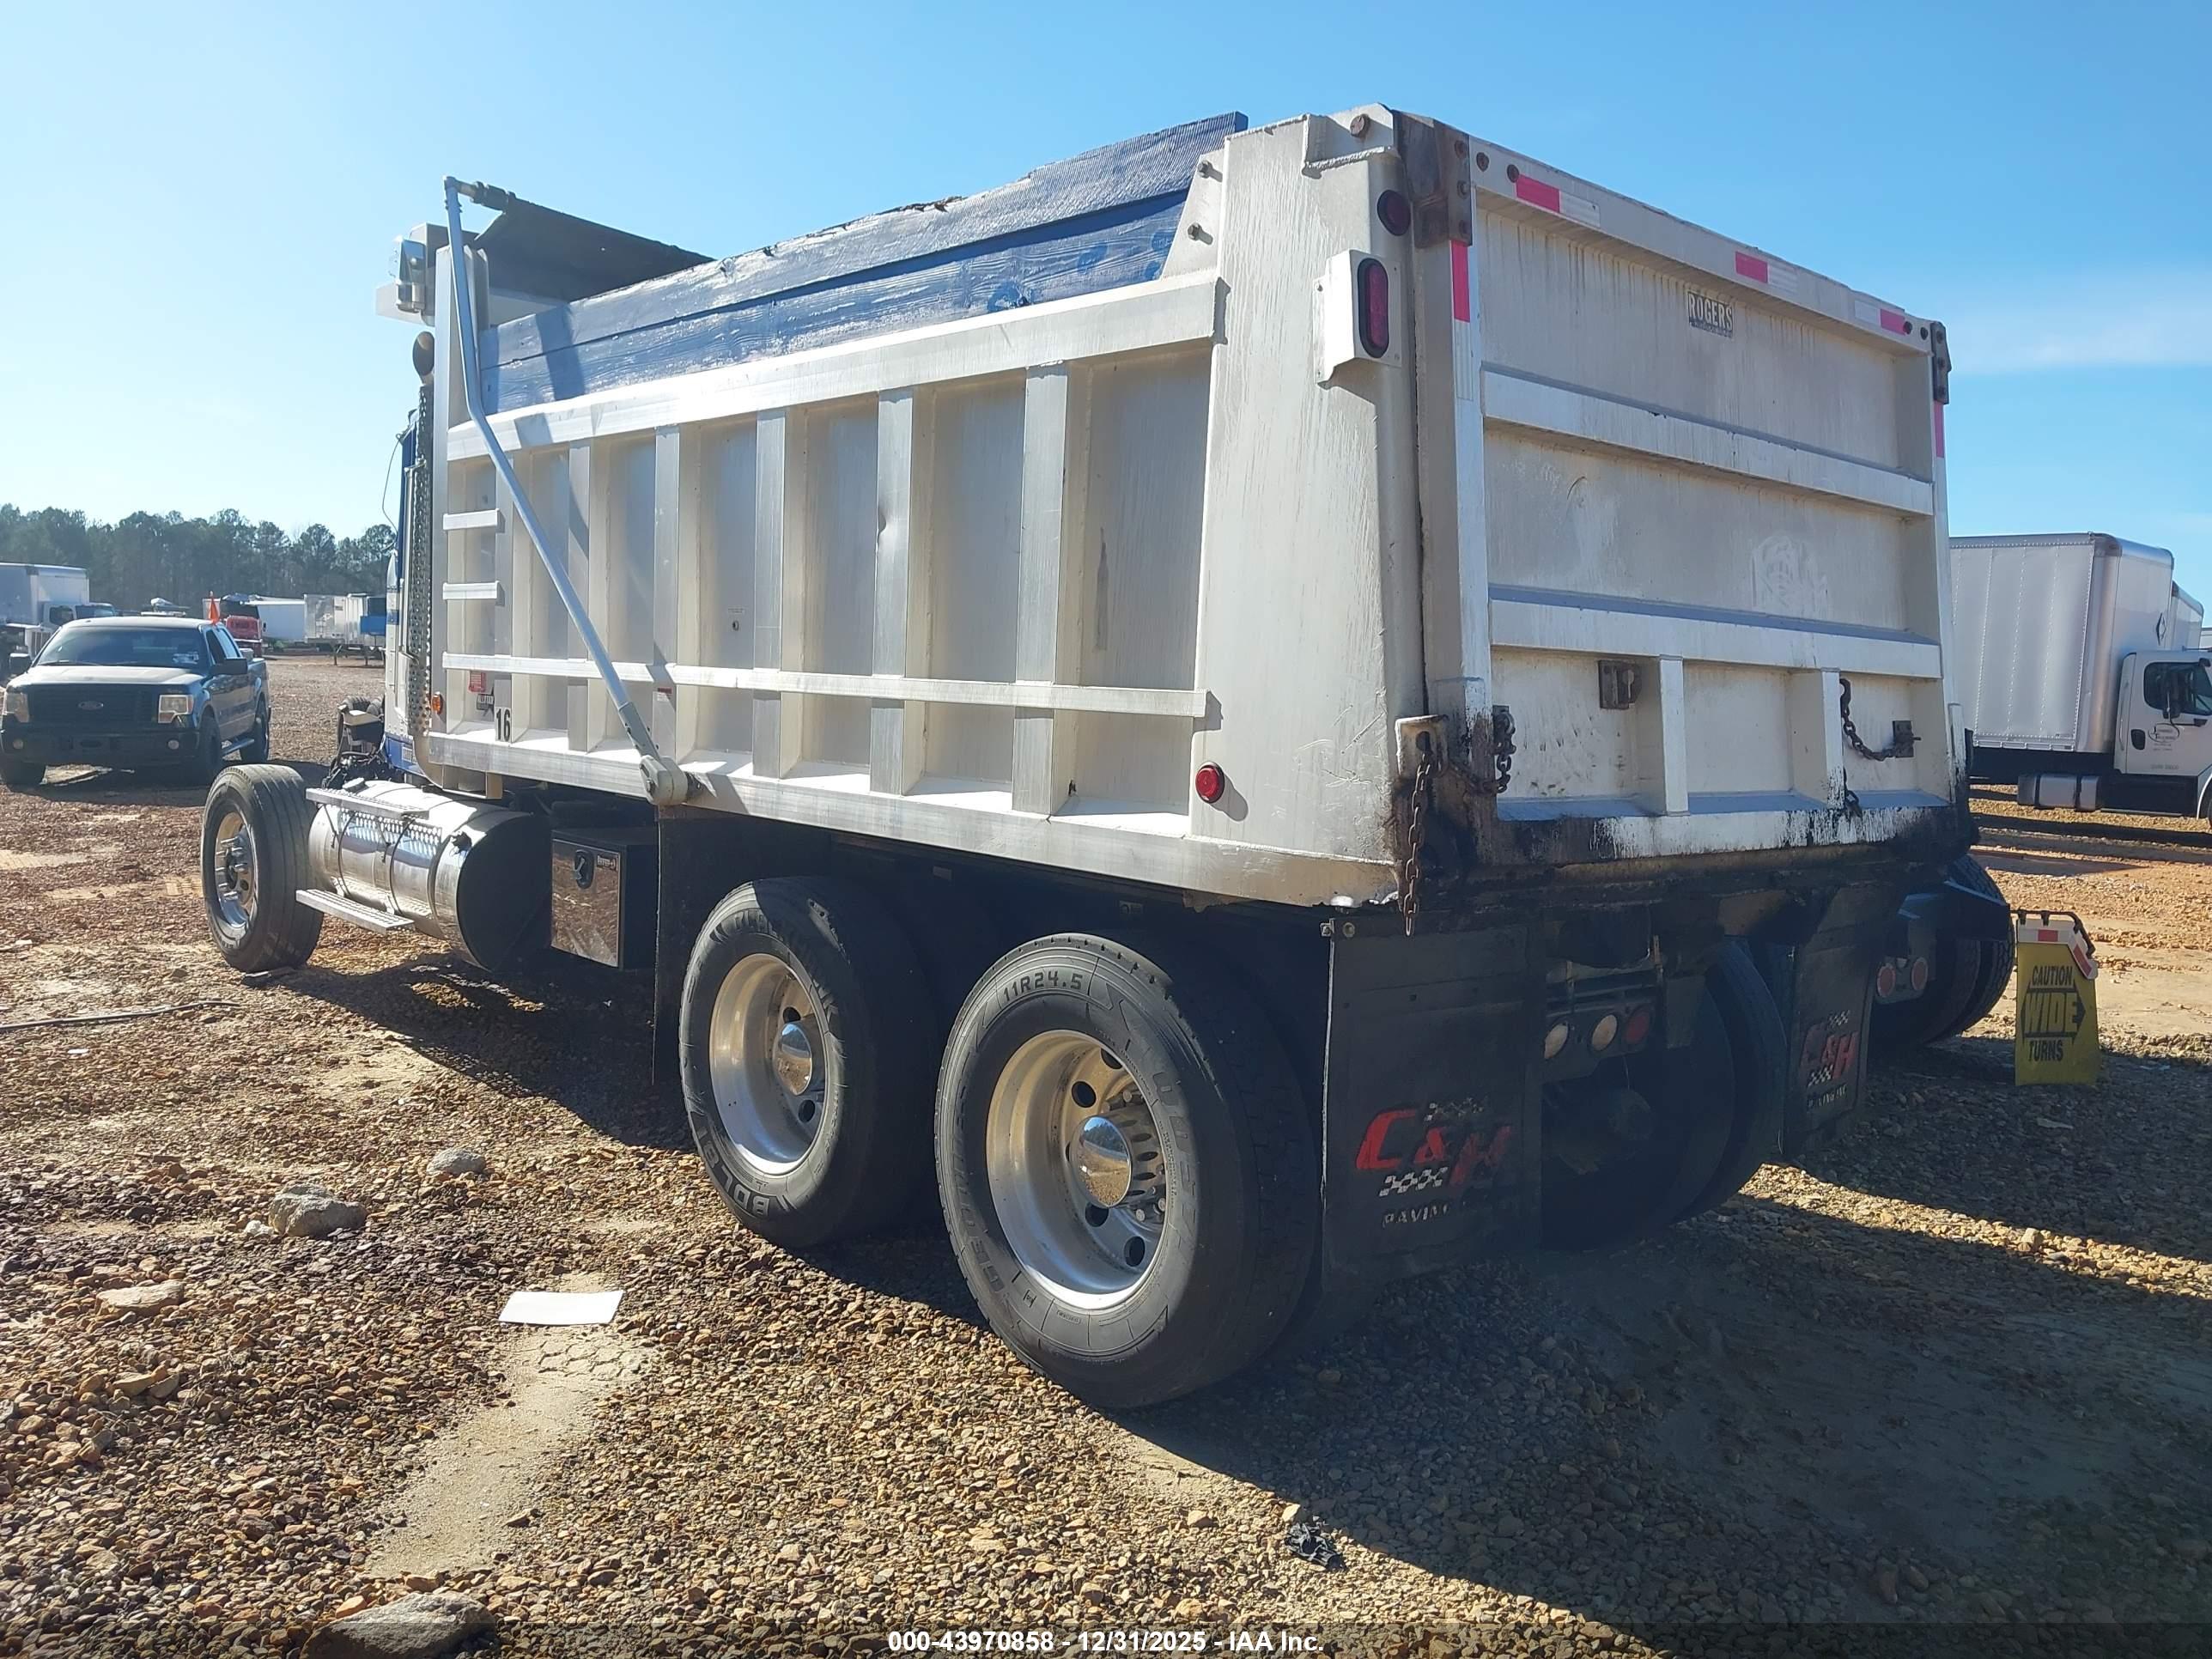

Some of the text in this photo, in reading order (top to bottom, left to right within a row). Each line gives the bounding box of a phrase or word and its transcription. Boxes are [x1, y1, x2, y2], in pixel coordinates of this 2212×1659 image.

[1688, 293, 1733, 331] ROGERS
[495, 708, 511, 742] 16
[1003, 970, 1084, 1002] 11R24.5
[2031, 964, 2074, 987] CAUTION
[2024, 992, 2078, 1033] WIDE
[2027, 1038, 2064, 1062] TURNS
